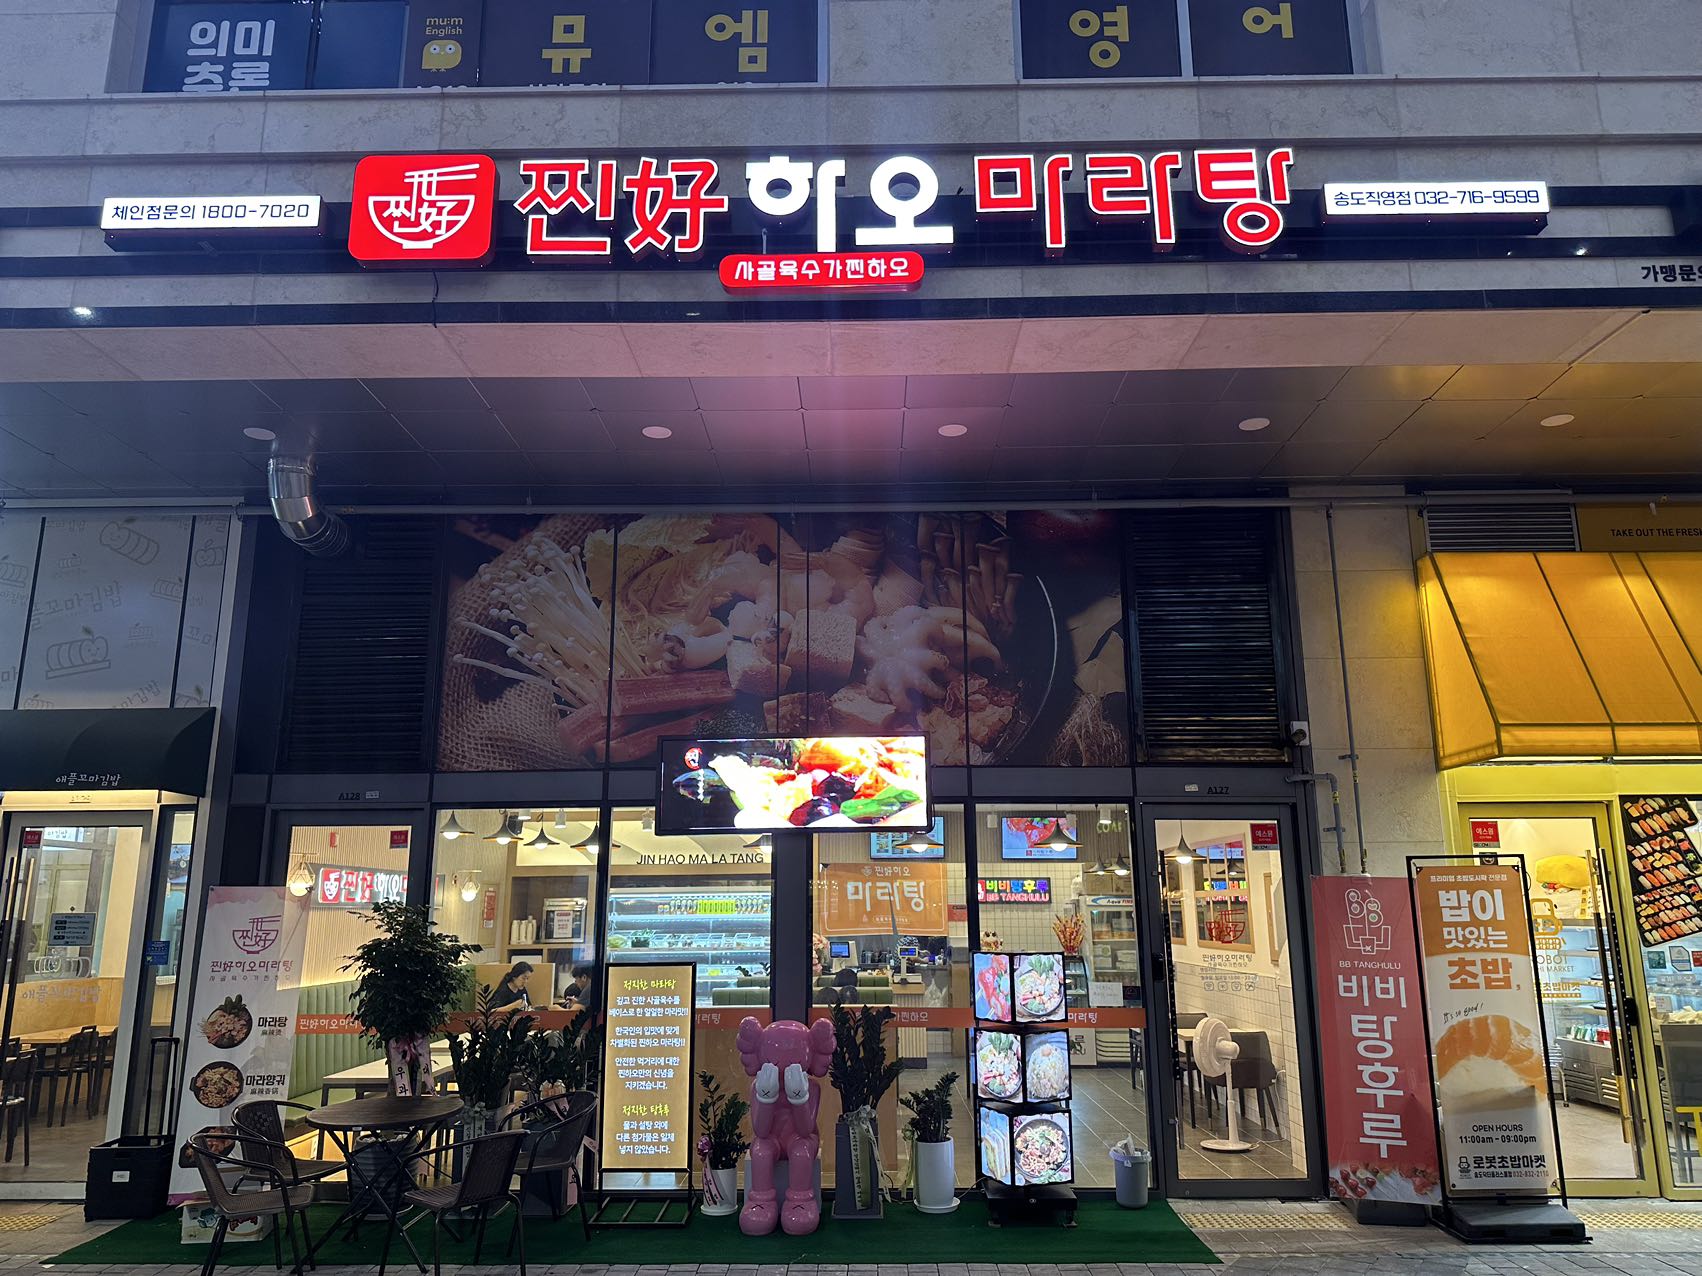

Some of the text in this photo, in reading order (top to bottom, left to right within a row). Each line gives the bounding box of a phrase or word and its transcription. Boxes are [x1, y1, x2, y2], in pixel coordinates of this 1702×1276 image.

[425, 26, 463, 36] English
[187, 19, 275, 57] 의미
[973, 148, 1294, 249] 마라탕
[1333, 189, 1540, 206] 송도직영점 032-716-9599
[111, 203, 310, 221] 체인점문의 1800-7020
[1610, 528, 1634, 537] TAKE
[1635, 528, 1654, 537] OUT
[1656, 528, 1675, 537] THE
[55, 772, 122, 787] 애플꼬마김밥
[1207, 786, 1230, 795] A127
[636, 853, 764, 865] JIN HAO MA LA TANG
[846, 880, 926, 912] 마라탕
[1438, 889, 1506, 922] 밥이
[1443, 927, 1509, 949] 맛있는
[1339, 960, 1401, 970] BB TANGHULU
[1537, 955, 1568, 965] OBOT
[1547, 965, 1575, 973] MARKET
[1337, 974, 1407, 1009] 비비
[257, 1016, 288, 1028] 마라탕
[1472, 1124, 1524, 1132] OPEN HOURS
[1459, 1135, 1494, 1143] 11:00am
[1501, 1134, 1537, 1144] 09:00pm
[1473, 1154, 1547, 1169] 로봇초밥마켓
